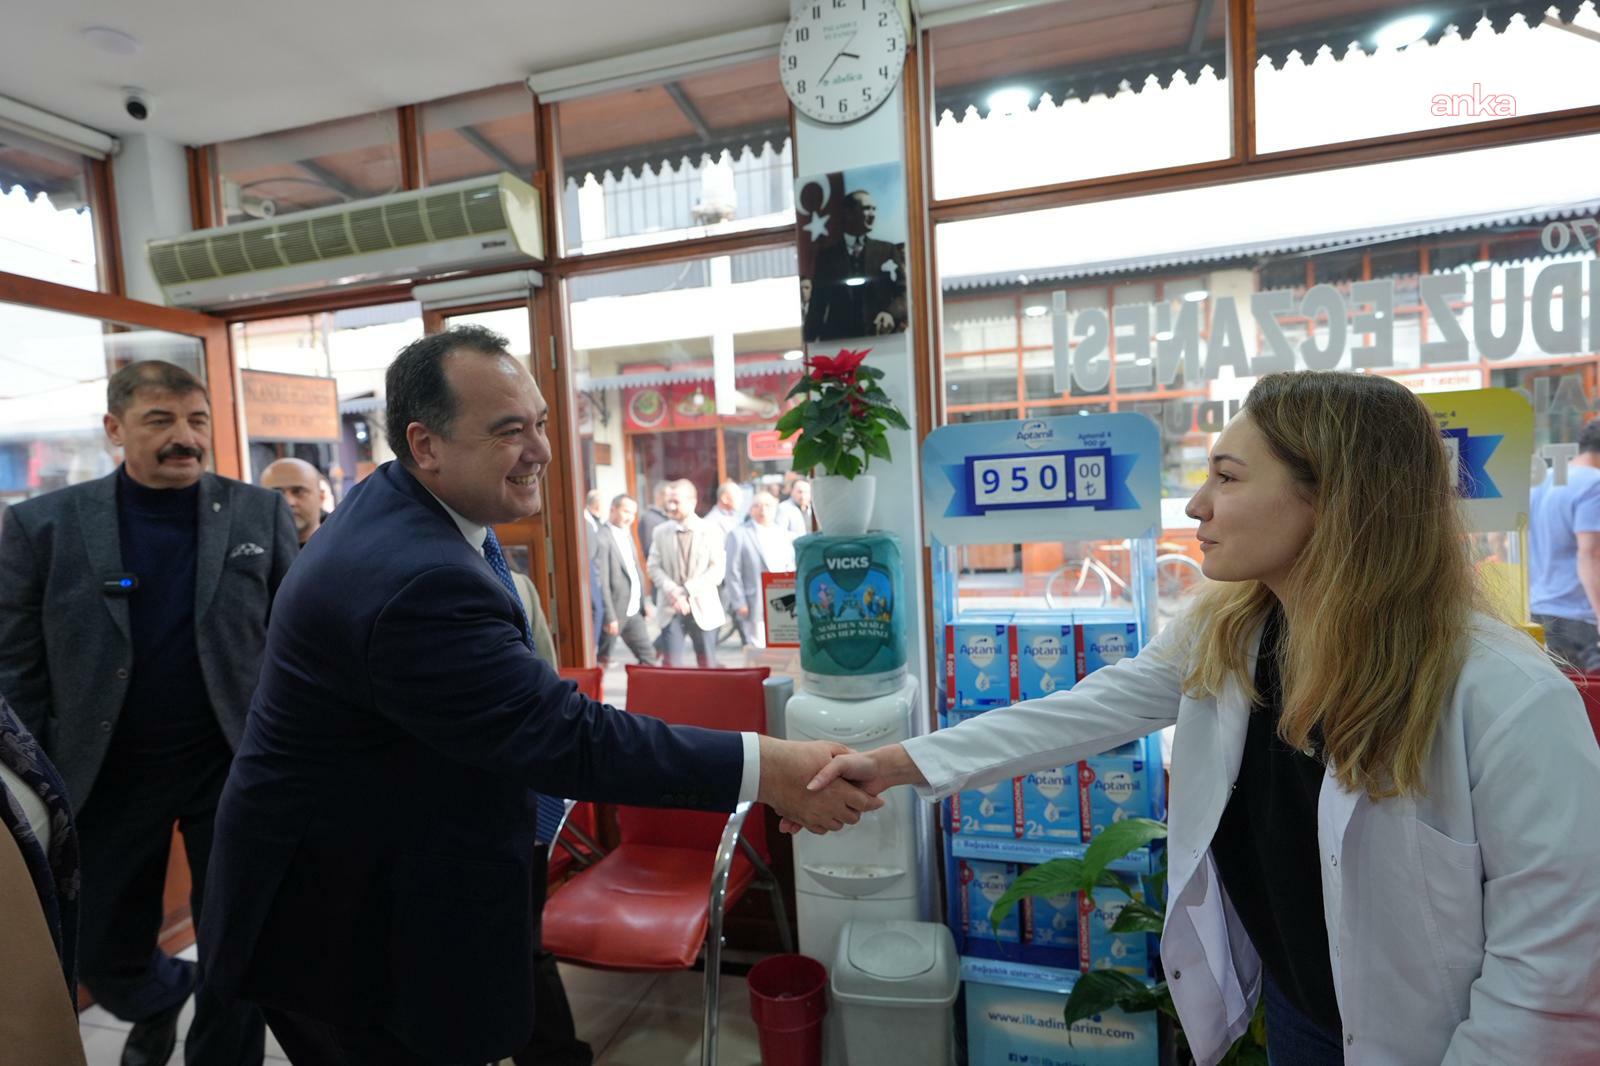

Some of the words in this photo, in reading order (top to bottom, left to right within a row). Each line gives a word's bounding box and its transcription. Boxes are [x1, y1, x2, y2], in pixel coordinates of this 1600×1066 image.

[813, 5, 821, 20] 11
[879, 12, 888, 28] 2
[796, 27, 810, 43] 10
[887, 37, 896, 53] 3
[788, 55, 797, 70] 9
[879, 65, 888, 80] 4
[797, 80, 806, 94] 8
[862, 87, 872, 102] 5
[816, 95, 824, 109] 7
[839, 98, 848, 113] 6
[1016, 430, 1054, 441] Aptamil
[1079, 463, 1101, 478] 00
[826, 557, 869, 570] VICKS
[960, 644, 1003, 656] Aptamil
[1024, 645, 1068, 656] Aptamil
[1090, 643, 1134, 654] Aptamil
[1027, 774, 1072, 787] Aptamil
[1094, 780, 1141, 792] Aptamil
[988, 1010, 1135, 1041] www.ilkadimarim.com
